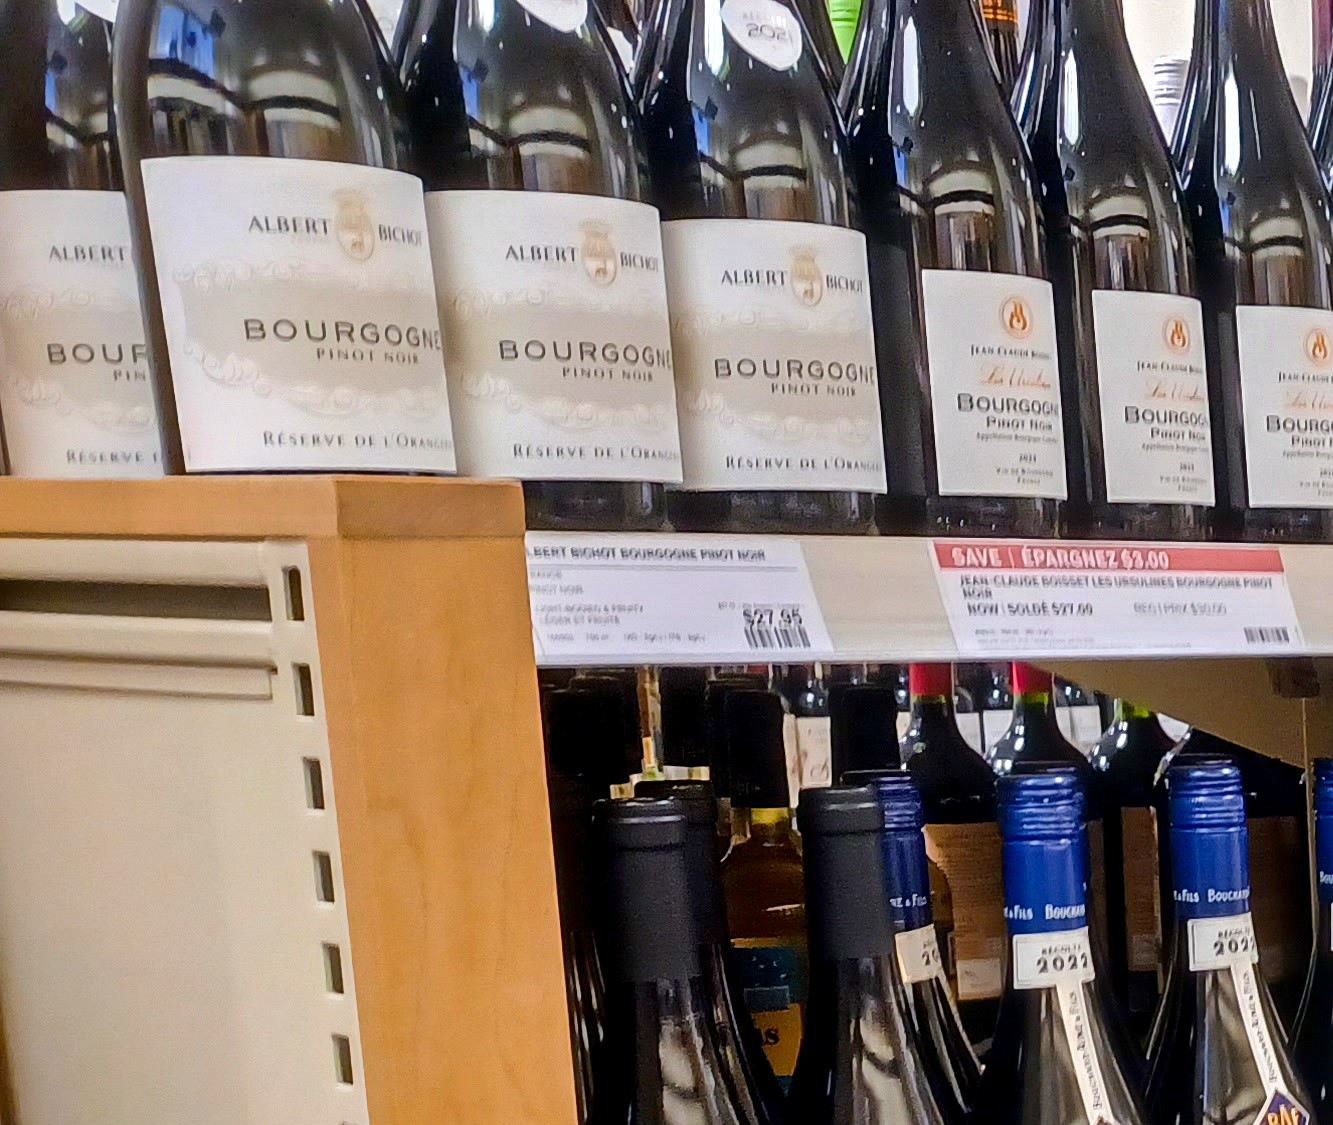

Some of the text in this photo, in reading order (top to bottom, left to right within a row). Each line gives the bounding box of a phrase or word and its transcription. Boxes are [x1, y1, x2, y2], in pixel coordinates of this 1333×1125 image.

[249, 215, 331, 236] ALBERT
[49, 244, 128, 263] ALBERT
[505, 243, 577, 263] ALBERT
[721, 269, 787, 287] ALBERT
[244, 319, 441, 351] BOURGOGNE
[316, 347, 420, 365] PINOT NOIR
[562, 366, 654, 383] PINOT NOIR
[771, 383, 857, 398] PINOT NOIR
[355, 432, 378, 449] DE
[594, 445, 615, 458] DE
[800, 457, 818, 470] DE
[620, 548, 698, 560] BOURGOGNE
[952, 548, 1002, 567] SAVE
[1022, 546, 1118, 569] ÉPARGNEZ
[742, 608, 803, 626] $27.95
[968, 603, 999, 616] NOW
[1036, 955, 1089, 974] 2022
